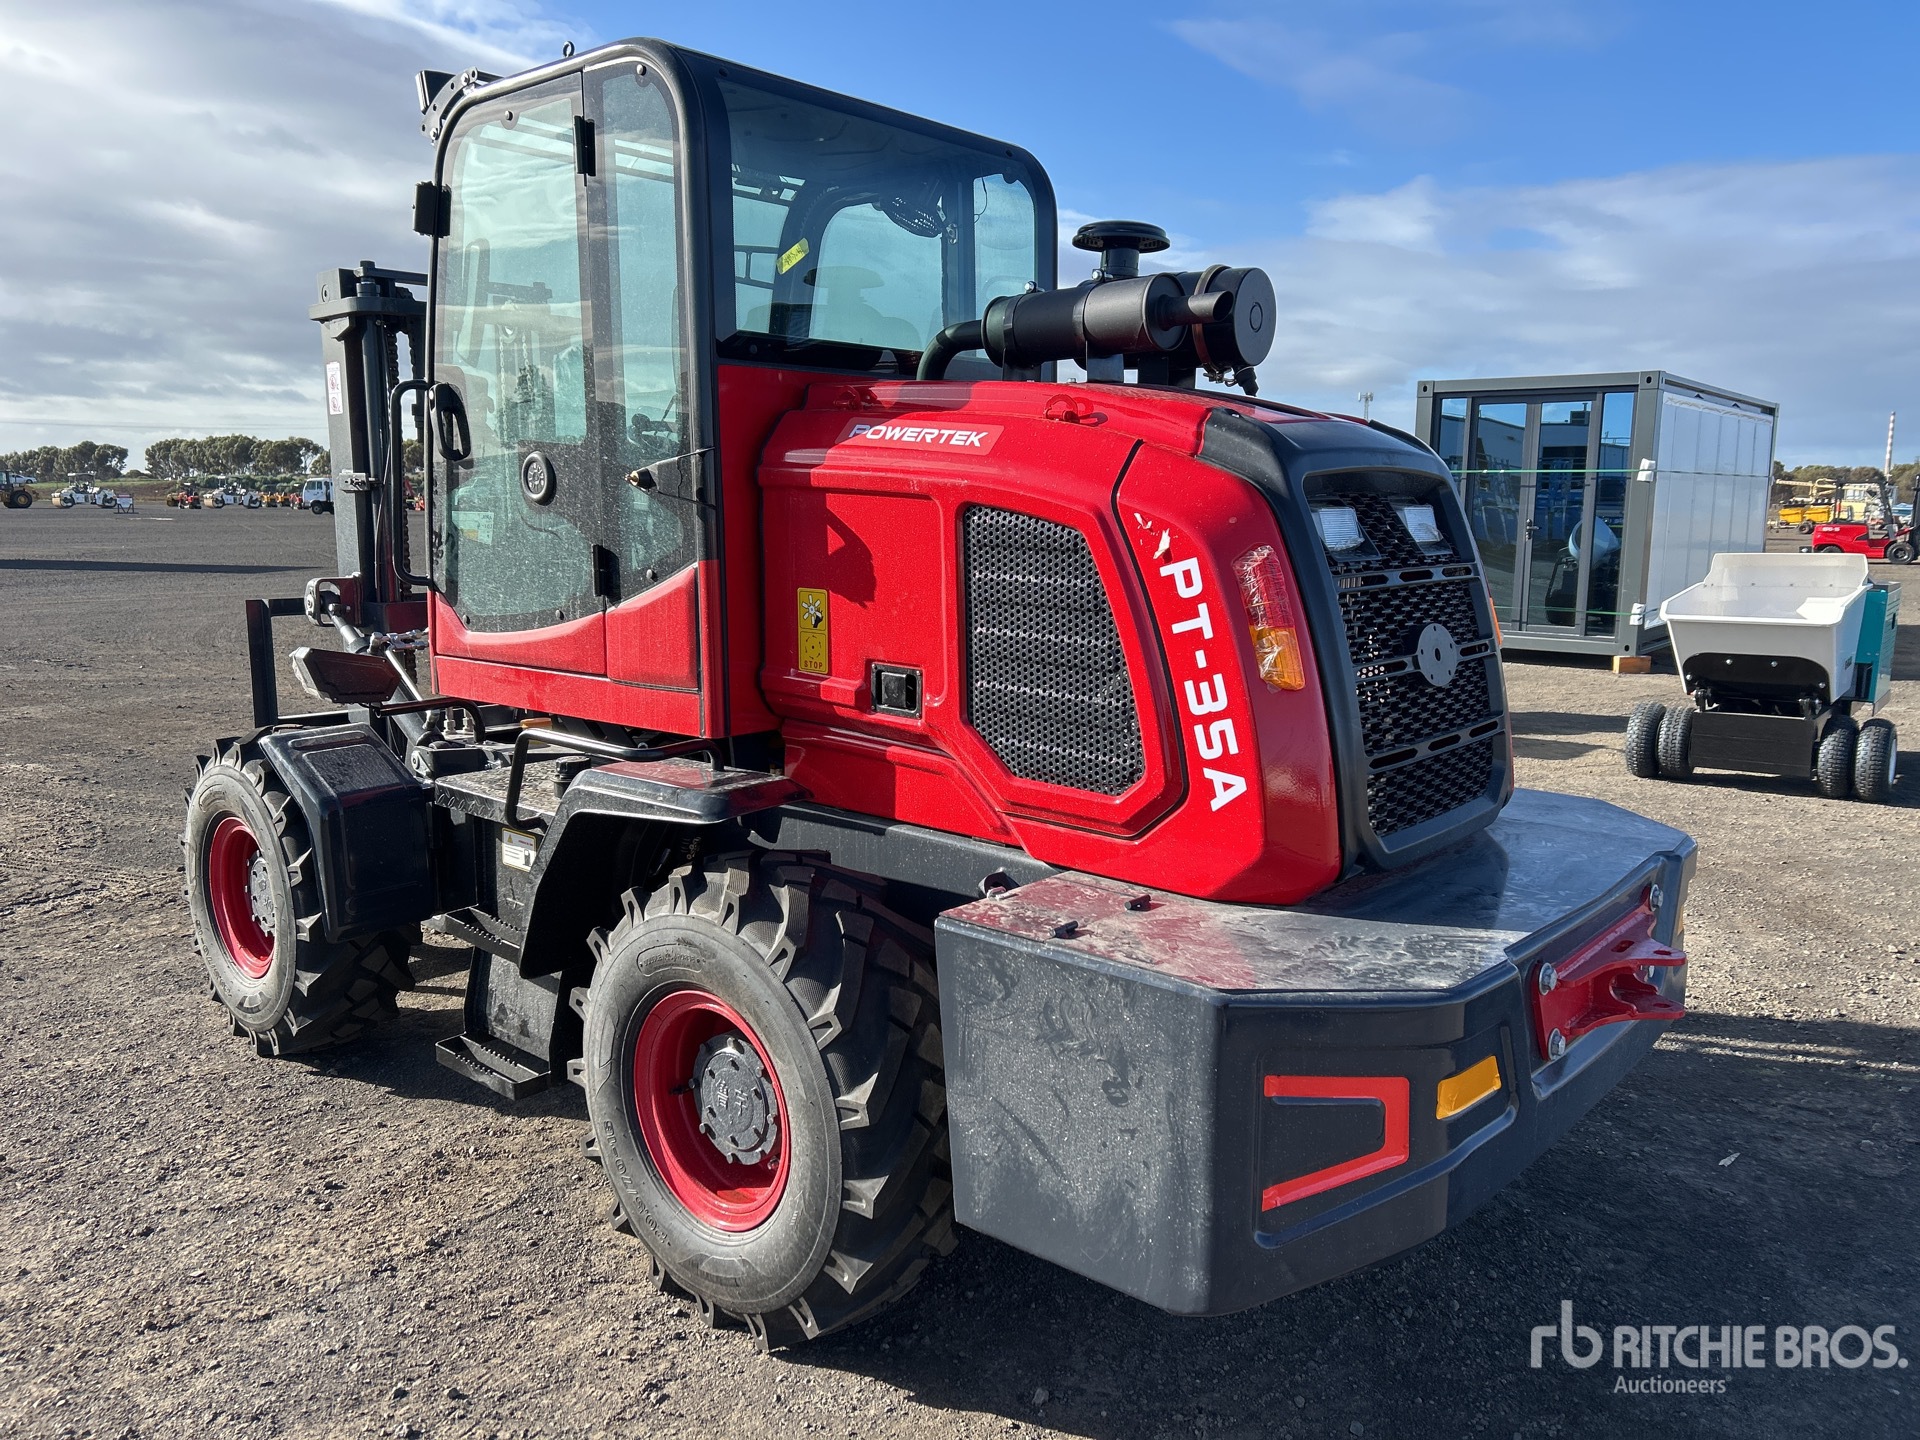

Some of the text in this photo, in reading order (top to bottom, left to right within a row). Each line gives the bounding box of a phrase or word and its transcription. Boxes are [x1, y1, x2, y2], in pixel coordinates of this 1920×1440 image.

[849, 424, 988, 447] POWERTEK
[804, 660, 823, 669] STOP
[1160, 557, 1248, 812] PT-35A
